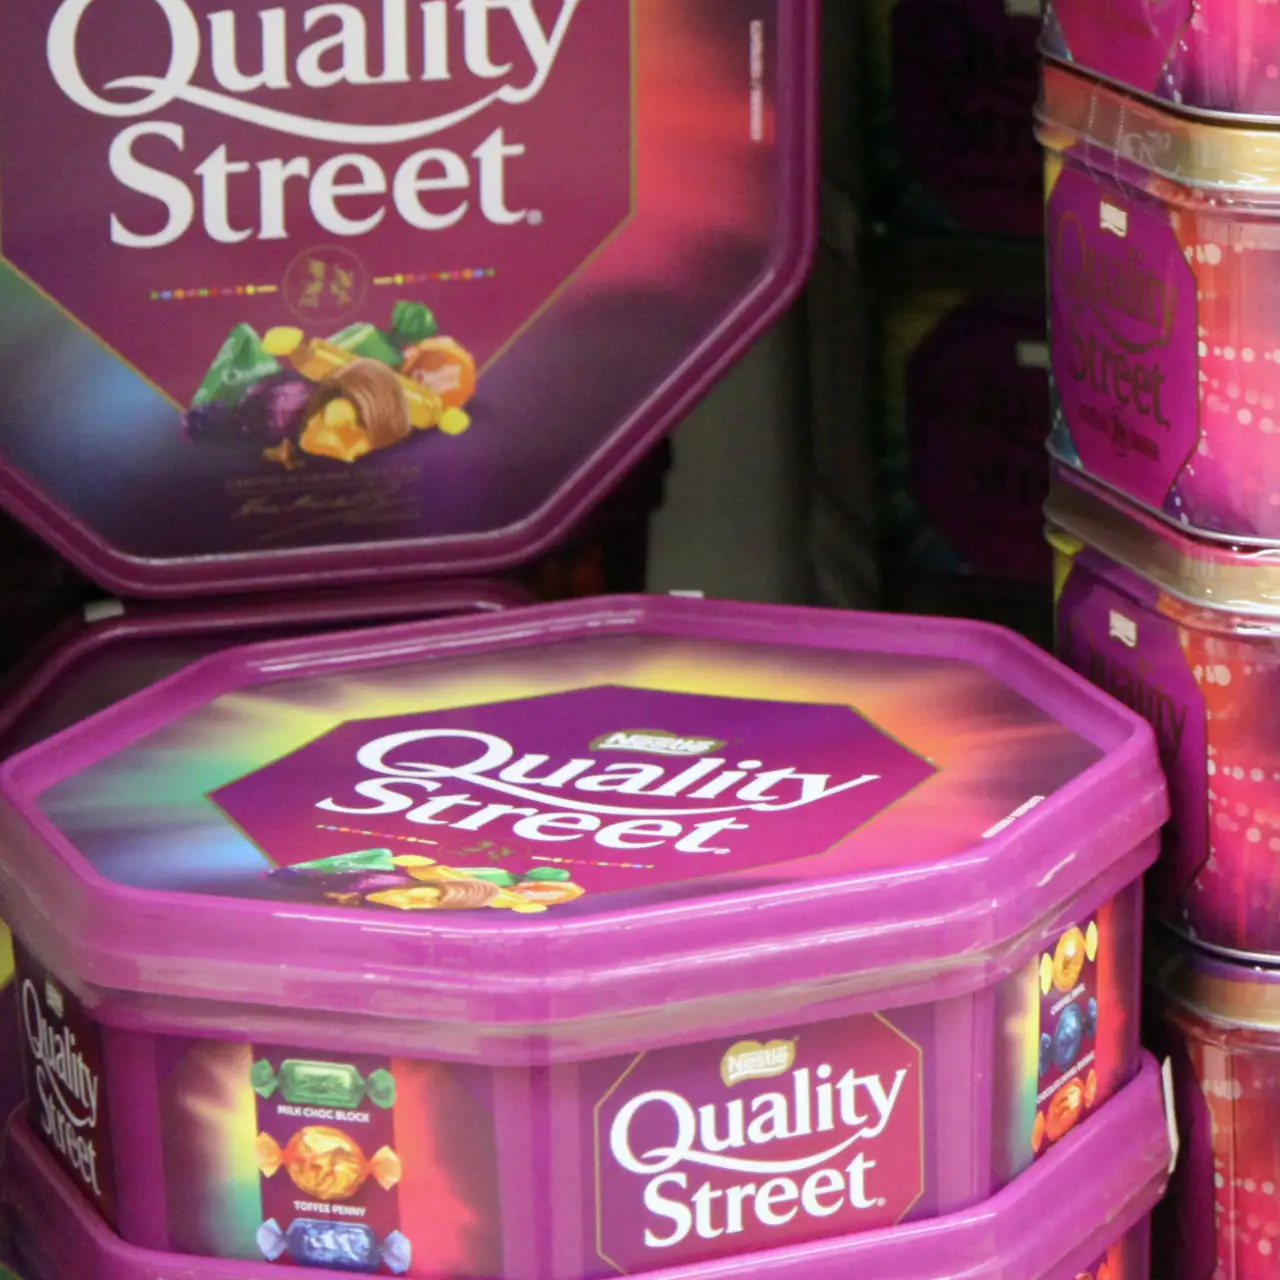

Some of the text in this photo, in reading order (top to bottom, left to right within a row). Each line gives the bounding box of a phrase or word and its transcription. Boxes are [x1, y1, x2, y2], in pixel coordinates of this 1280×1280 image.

[108, 120, 530, 248] Street
[316, 777, 748, 853] Street
[356, 728, 881, 816] Quality
[22, 978, 99, 1128] Quality
[728, 1046, 789, 1073] Nestlé
[36, 1065, 102, 1196] Street
[609, 1063, 910, 1174] Quality
[294, 1201, 365, 1216] TOFFEE PENNY
[643, 1152, 878, 1247] Street
